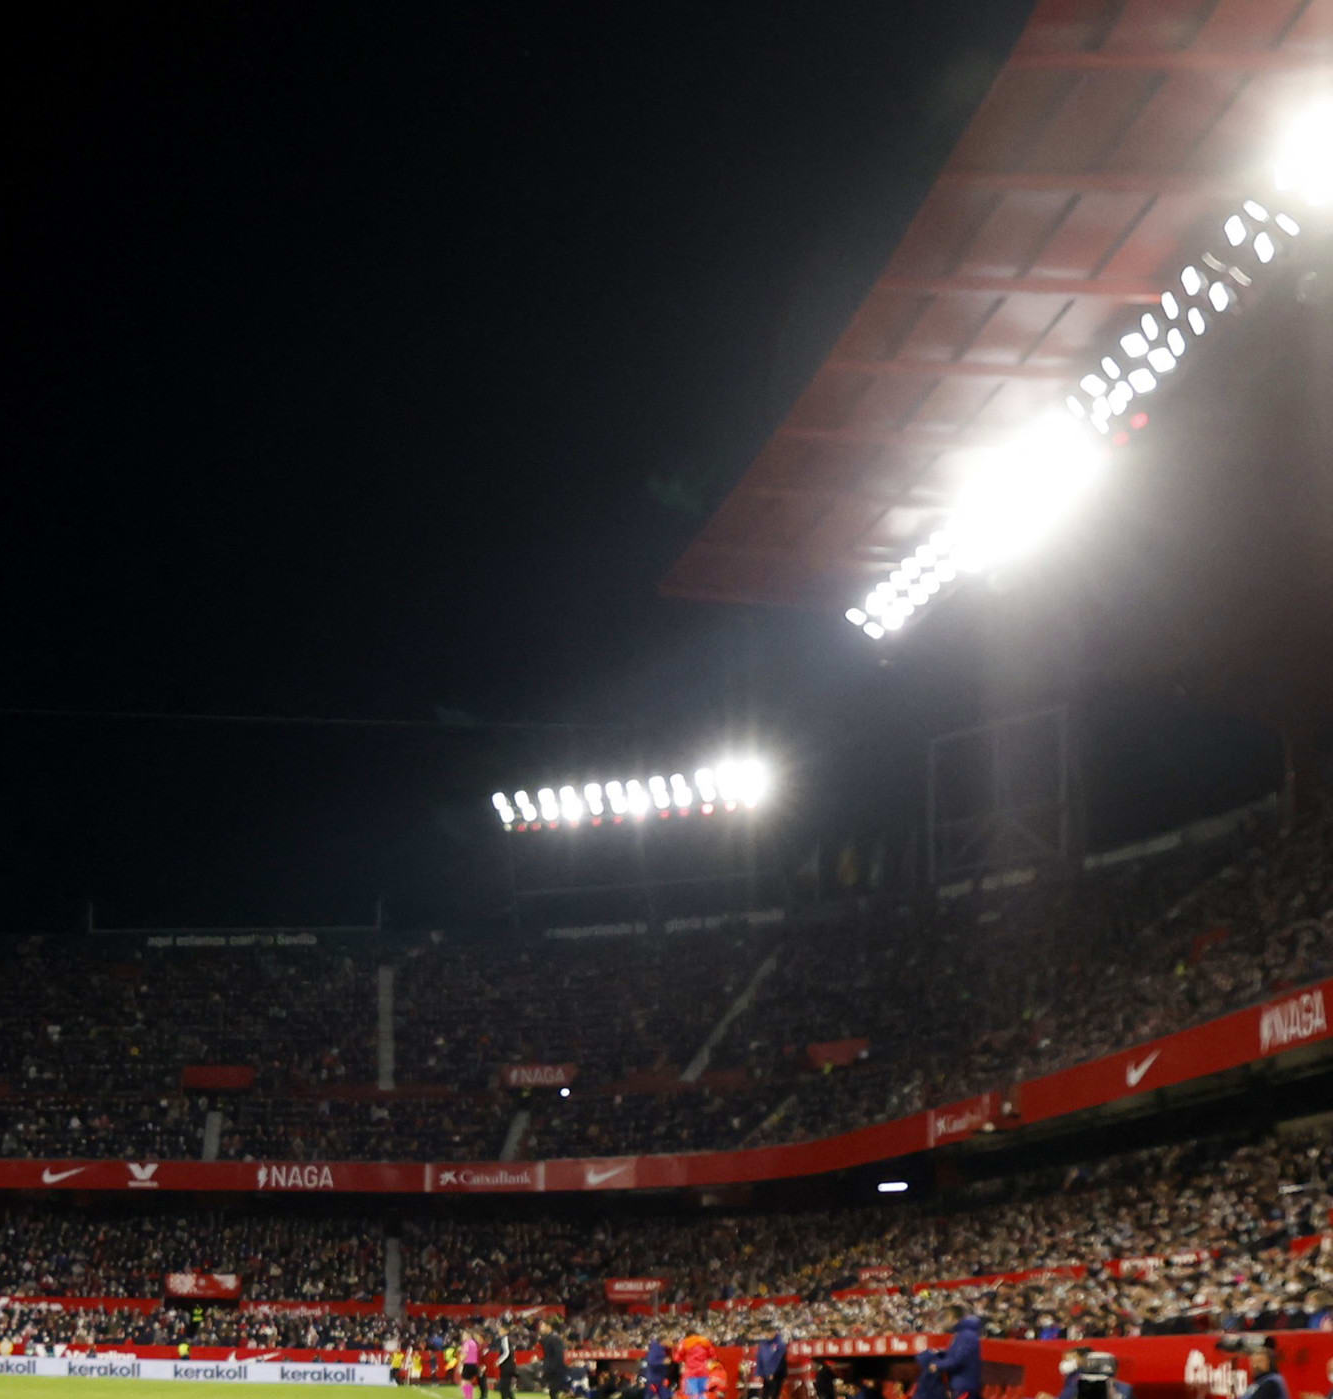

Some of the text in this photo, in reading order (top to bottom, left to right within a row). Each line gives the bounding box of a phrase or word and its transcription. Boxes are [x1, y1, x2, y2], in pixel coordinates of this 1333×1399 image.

[271, 1165, 334, 1188] NAGA
[68, 1361, 140, 1377] kerakoll
[173, 1363, 248, 1380] kerakoll
[280, 1366, 356, 1382] kerakoll
